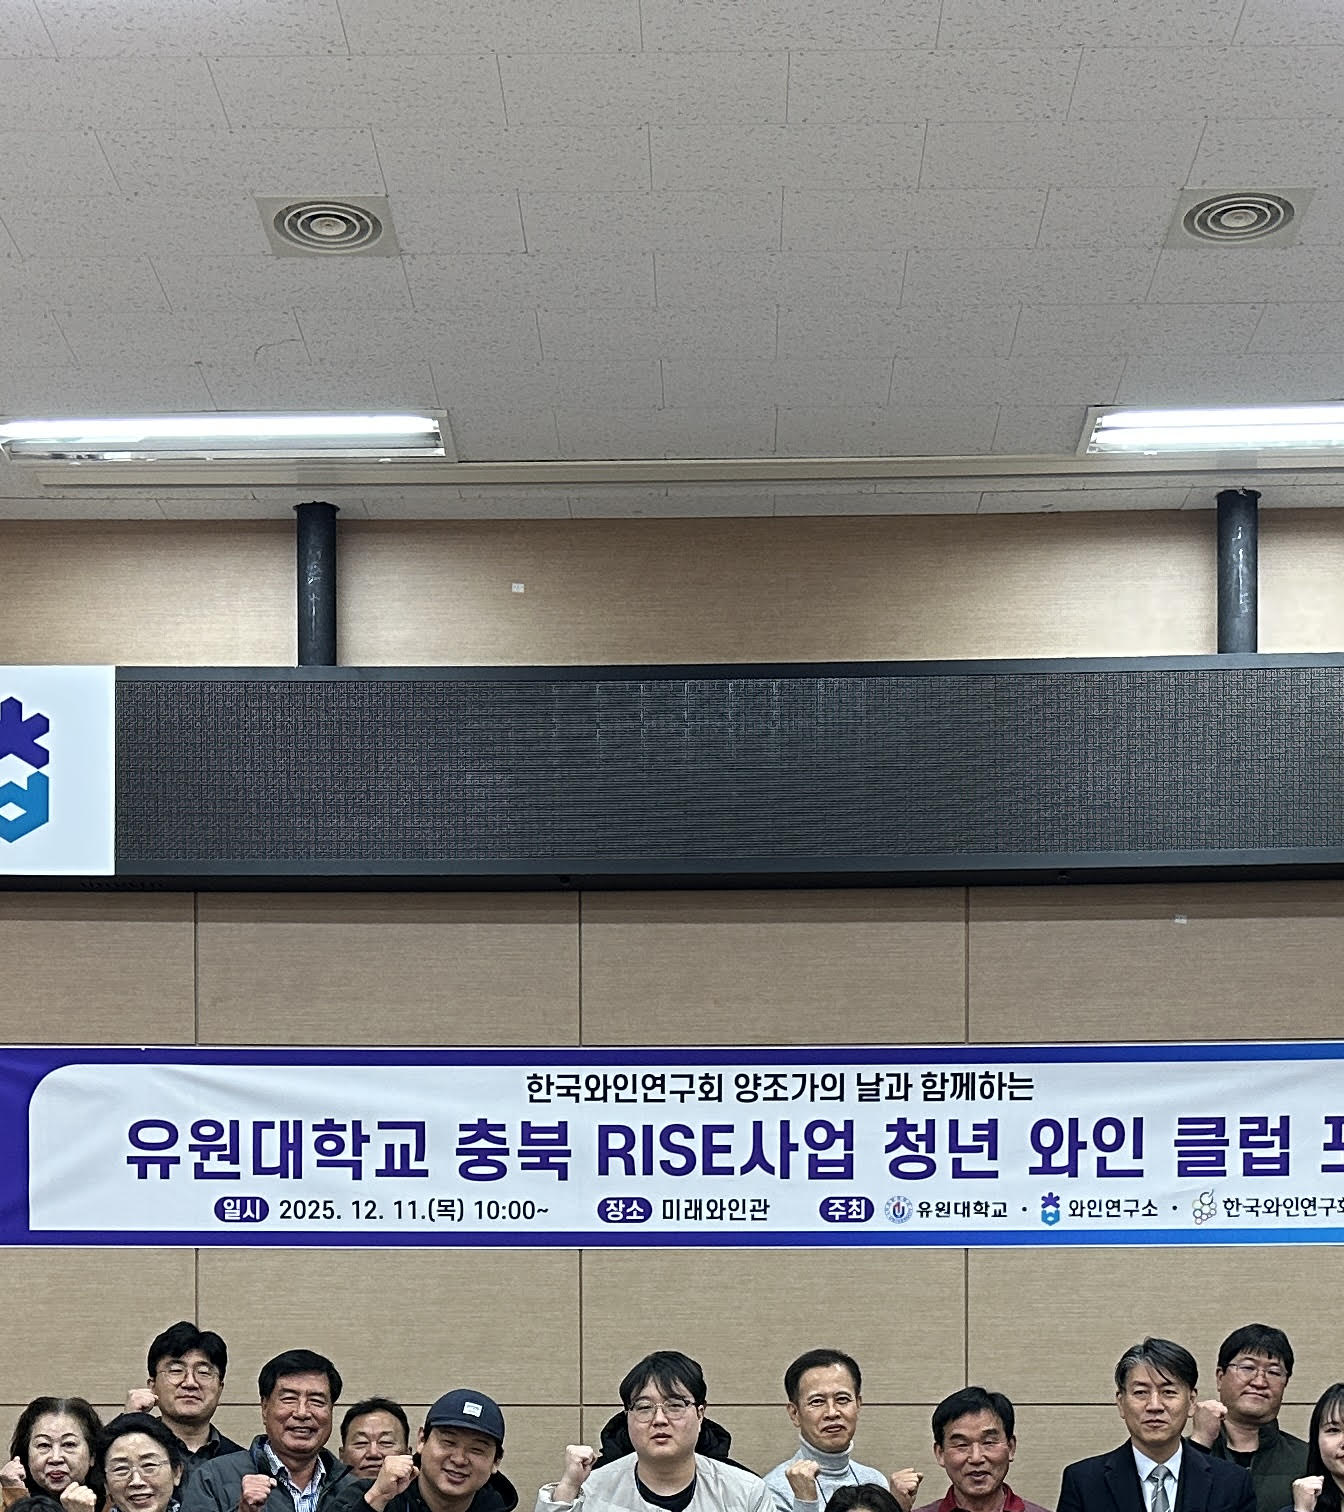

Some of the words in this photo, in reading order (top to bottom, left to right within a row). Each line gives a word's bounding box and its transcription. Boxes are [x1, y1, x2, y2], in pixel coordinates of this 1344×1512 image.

[526, 1072, 723, 1104] 한국와인연구회
[734, 1072, 845, 1104] 양조가의
[856, 1072, 914, 1103] 날과
[920, 1070, 1035, 1102] 함께하는
[126, 1118, 429, 1181] 유원대학교
[455, 1117, 572, 1182] 충북
[597, 1119, 854, 1181] RISE사업
[884, 1117, 999, 1181] 청년
[1028, 1116, 1145, 1179] 와인
[1173, 1114, 1291, 1178] 클럽
[222, 1200, 261, 1221] 일시
[279, 1199, 342, 1220] 2025.
[351, 1199, 384, 1220] 12.
[474, 1200, 549, 1220] 10:00~
[605, 1200, 646, 1221] 장소
[662, 1198, 771, 1222] 미래와인관
[827, 1200, 867, 1221] 주최
[916, 1200, 1008, 1219] 유원대학교
[1068, 1198, 1159, 1218] 와인연구소
